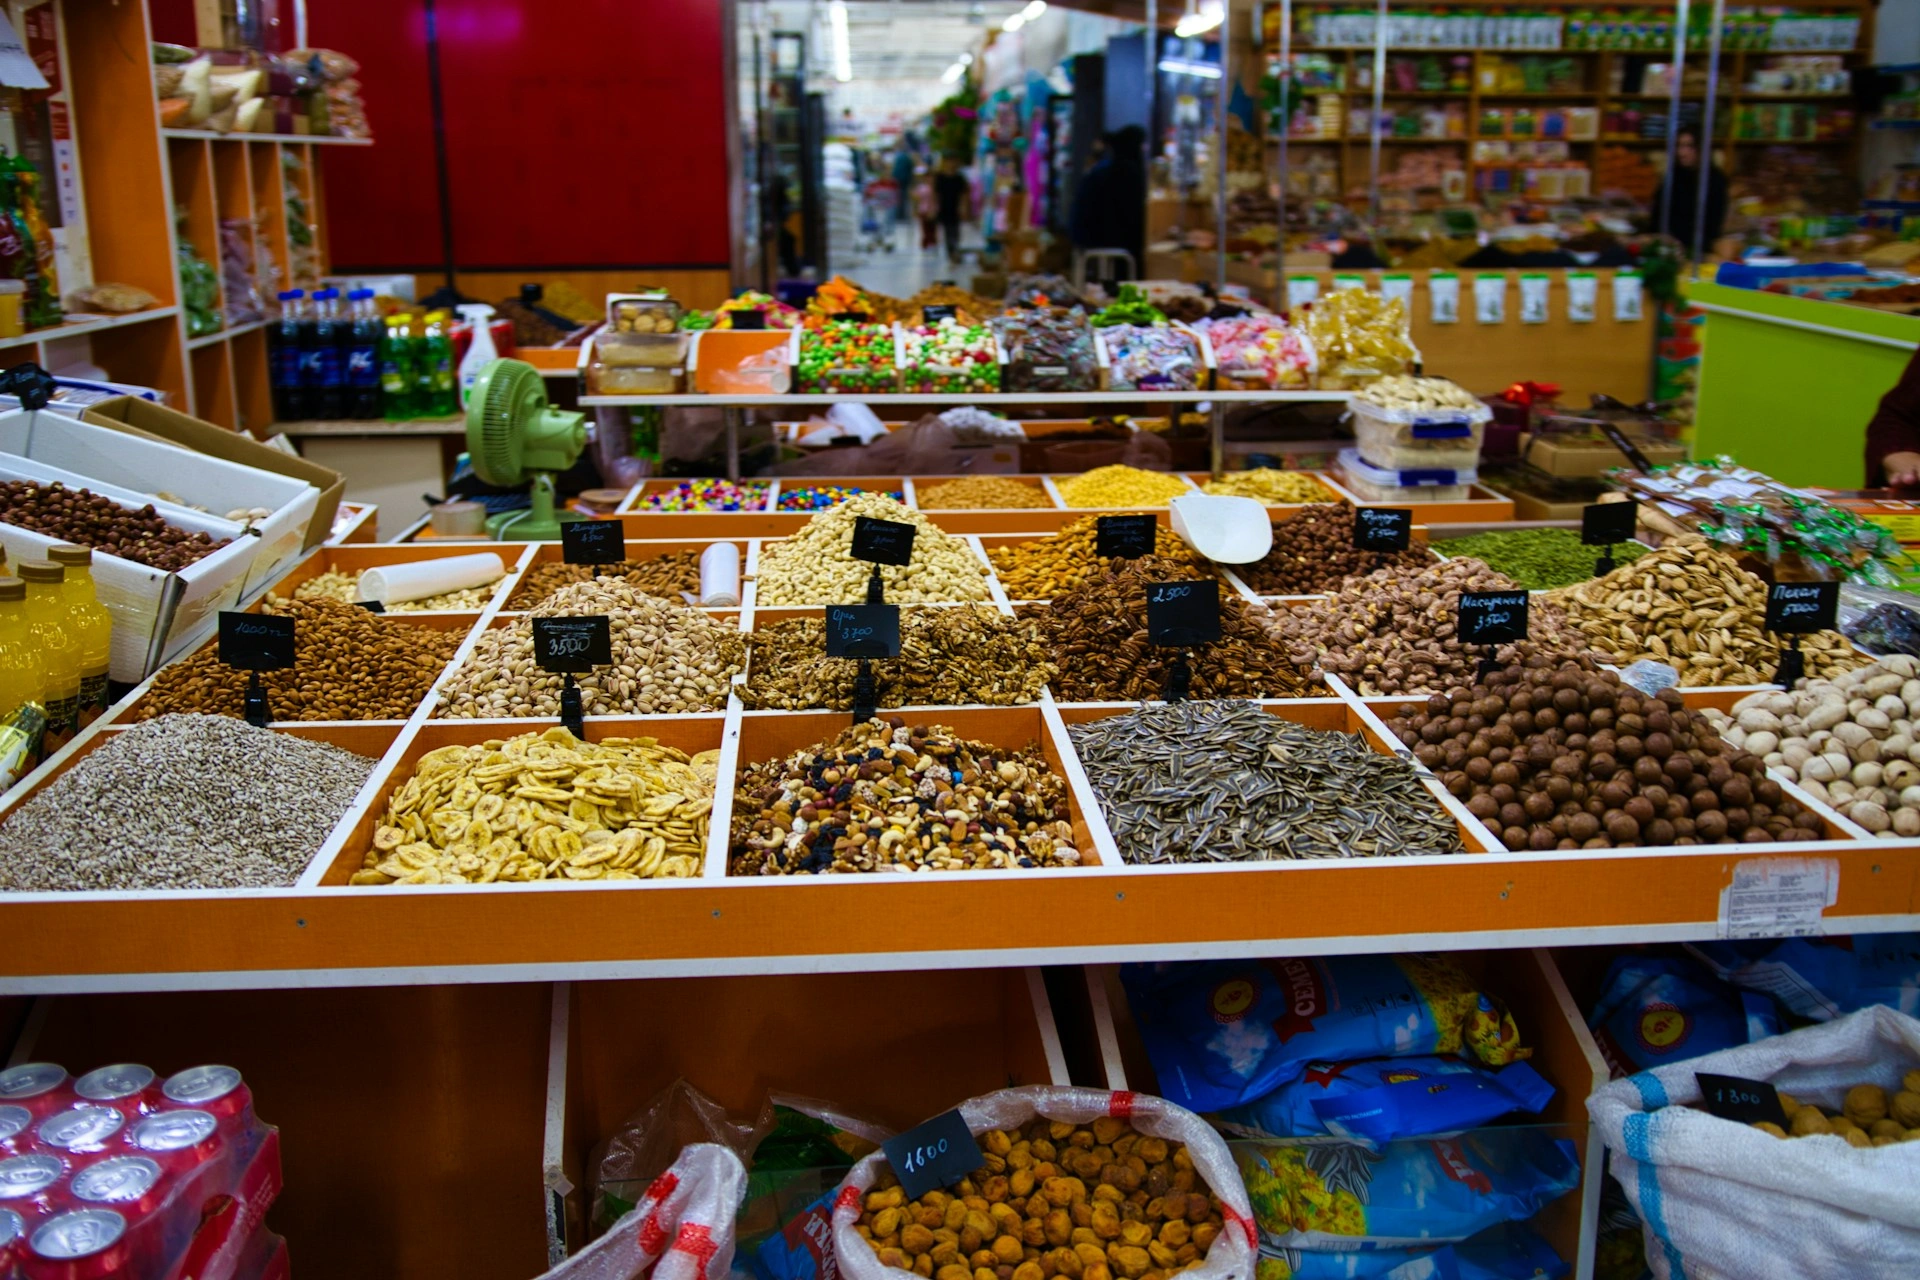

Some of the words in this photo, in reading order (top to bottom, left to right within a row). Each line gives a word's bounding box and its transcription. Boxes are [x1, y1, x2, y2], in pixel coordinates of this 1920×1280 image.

[1152, 585, 1192, 604] 2500
[1772, 584, 1821, 600] Пекан
[234, 621, 268, 636] 1000
[1474, 611, 1511, 631] 3500
[841, 626, 873, 640] 3700
[548, 635, 591, 656] 3500
[904, 1137, 949, 1173] 1600
